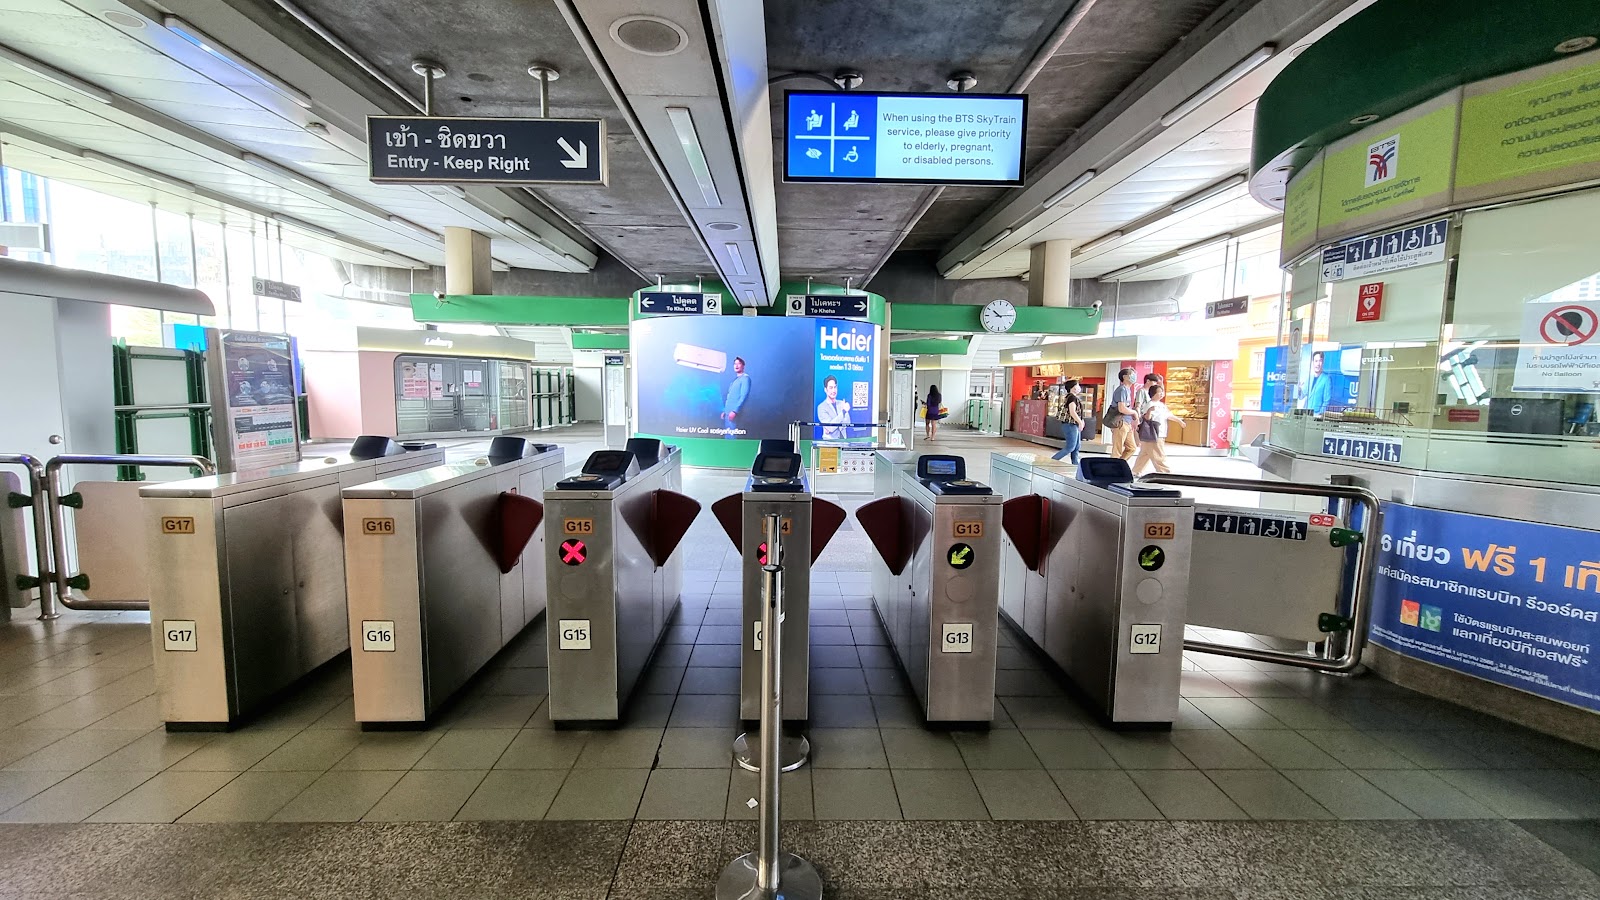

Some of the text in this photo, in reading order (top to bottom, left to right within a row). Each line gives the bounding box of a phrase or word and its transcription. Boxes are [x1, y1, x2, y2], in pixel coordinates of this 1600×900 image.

[882, 112, 1017, 126] When using the BTS SkyTrain
[385, 124, 419, 148] เข้า
[437, 125, 506, 149] ชิดขวา
[887, 128, 1011, 140] service, please give priority
[903, 142, 994, 154] to elderly, pregnant,
[387, 154, 429, 171] Entry
[443, 156, 484, 172] Keep
[488, 157, 530, 173] Right
[902, 155, 994, 167] or disabled persons.
[1362, 284, 1380, 295] AED
[672, 295, 697, 307] ไปคูคต
[820, 326, 872, 352] Haier
[1266, 371, 1286, 381] Haie
[165, 520, 190, 531] G17
[366, 521, 391, 532] G16
[566, 521, 591, 532] G15
[956, 524, 981, 535] G13
[1147, 526, 1172, 536] G12
[1380, 534, 1391, 552] 6
[1396, 530, 1451, 565] เที่ยว
[1461, 543, 1517, 577] ฟรี
[1529, 557, 1546, 583] 1
[1378, 565, 1598, 622] แค่สมัครสมาชิกแรบบิท รีวอร์ดส
[167, 630, 192, 642] G17
[366, 630, 391, 642] G16
[563, 629, 587, 641] G15
[946, 632, 969, 644] G13
[1134, 633, 1157, 645] G12
[1453, 612, 1590, 654] ใช้บัตรแรบบิทสะสมพอยท์
